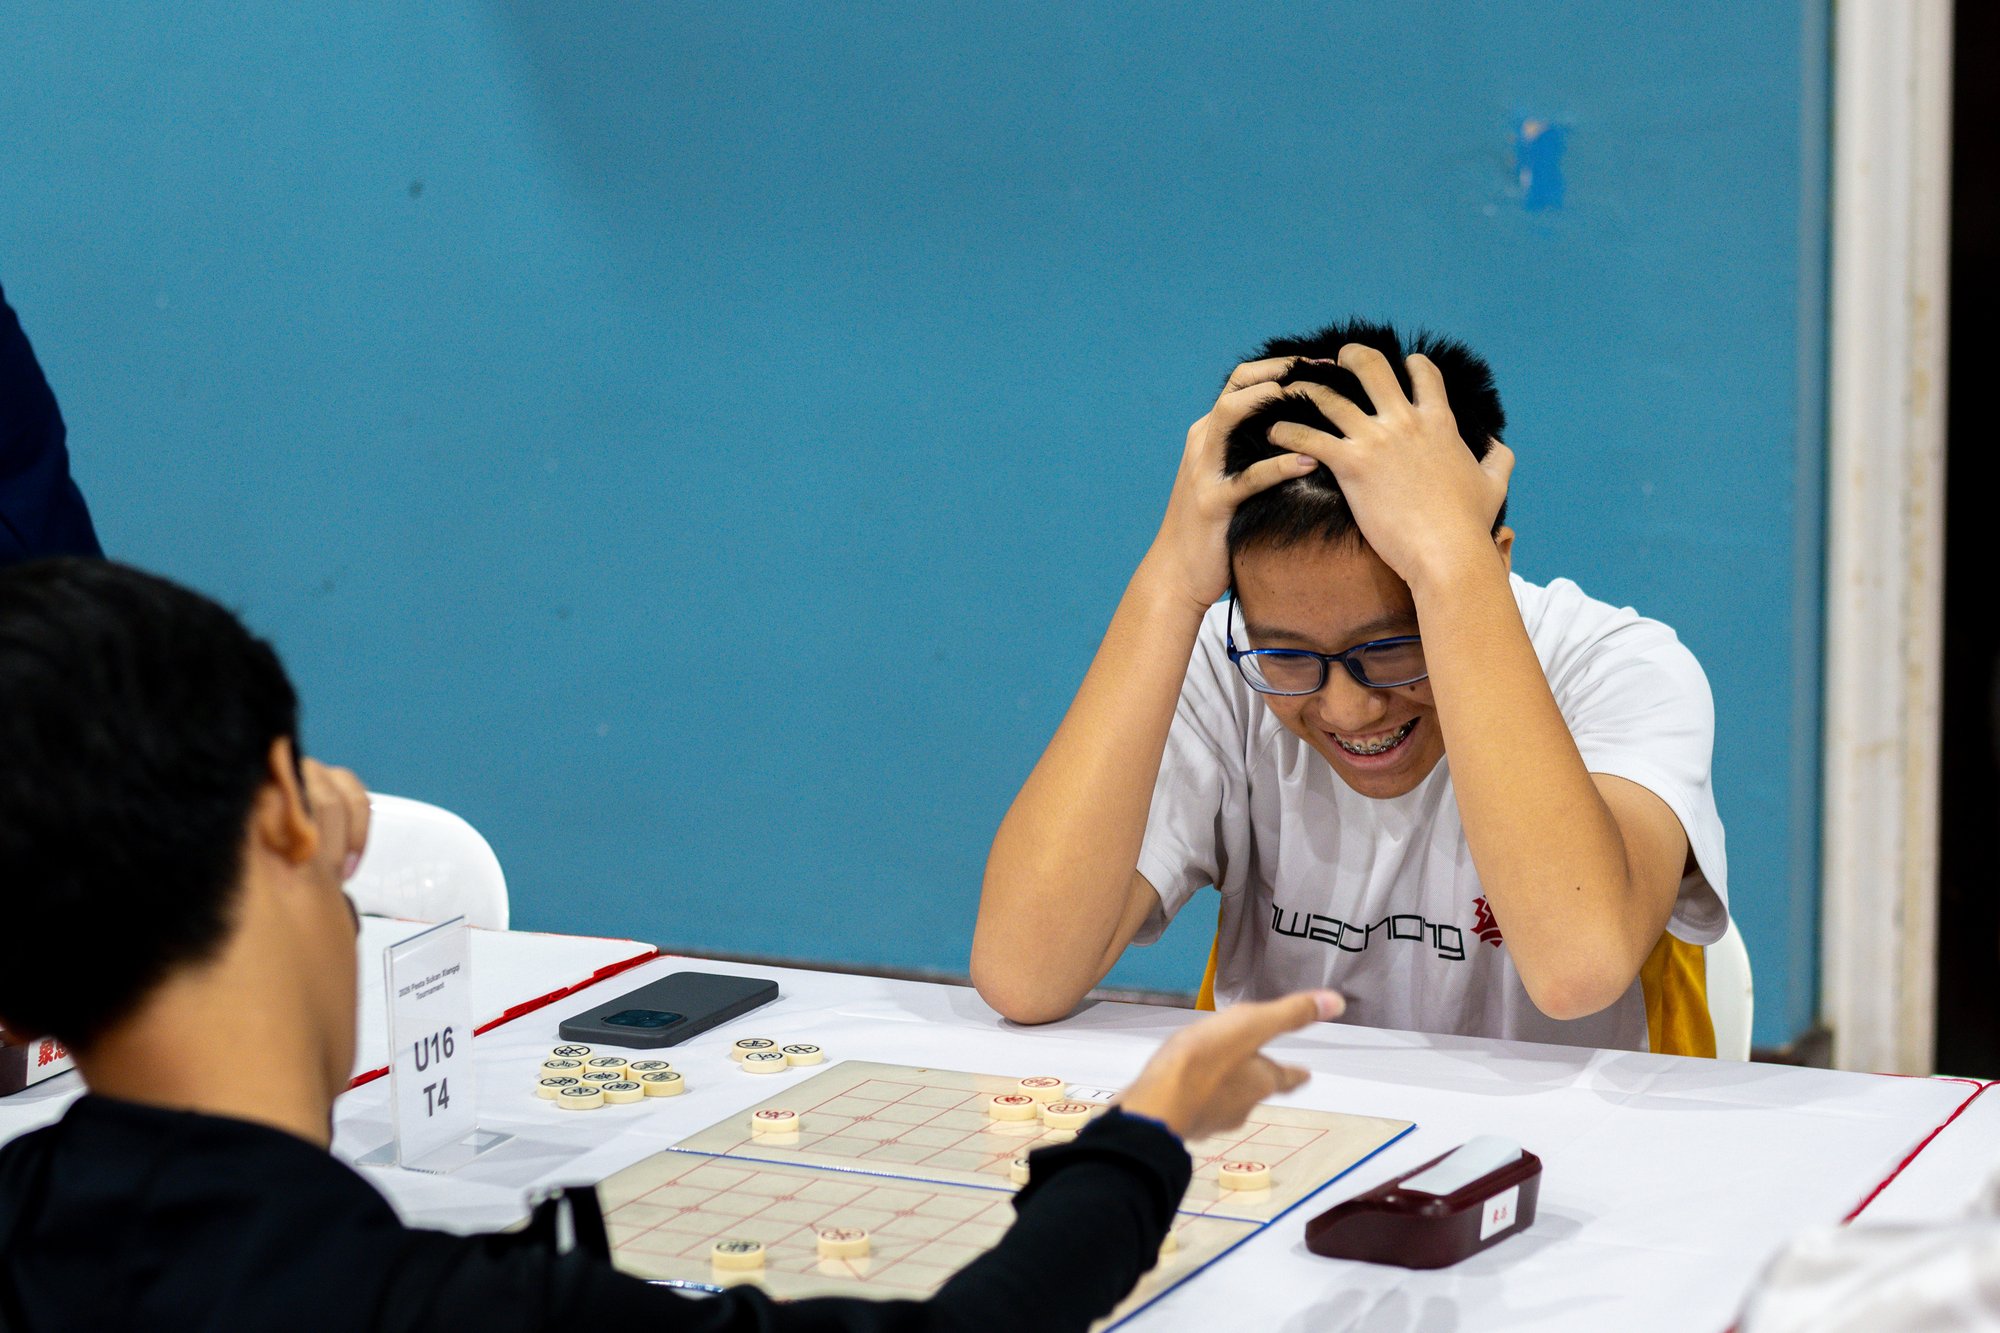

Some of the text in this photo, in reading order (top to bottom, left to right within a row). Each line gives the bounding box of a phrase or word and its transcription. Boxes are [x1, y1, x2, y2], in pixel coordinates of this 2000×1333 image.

[411, 981, 425, 991] Pesta
[426, 973, 441, 985] Sukan
[416, 982, 445, 1000] Tournament
[414, 1026, 454, 1072] U16
[423, 1077, 450, 1117] T4
